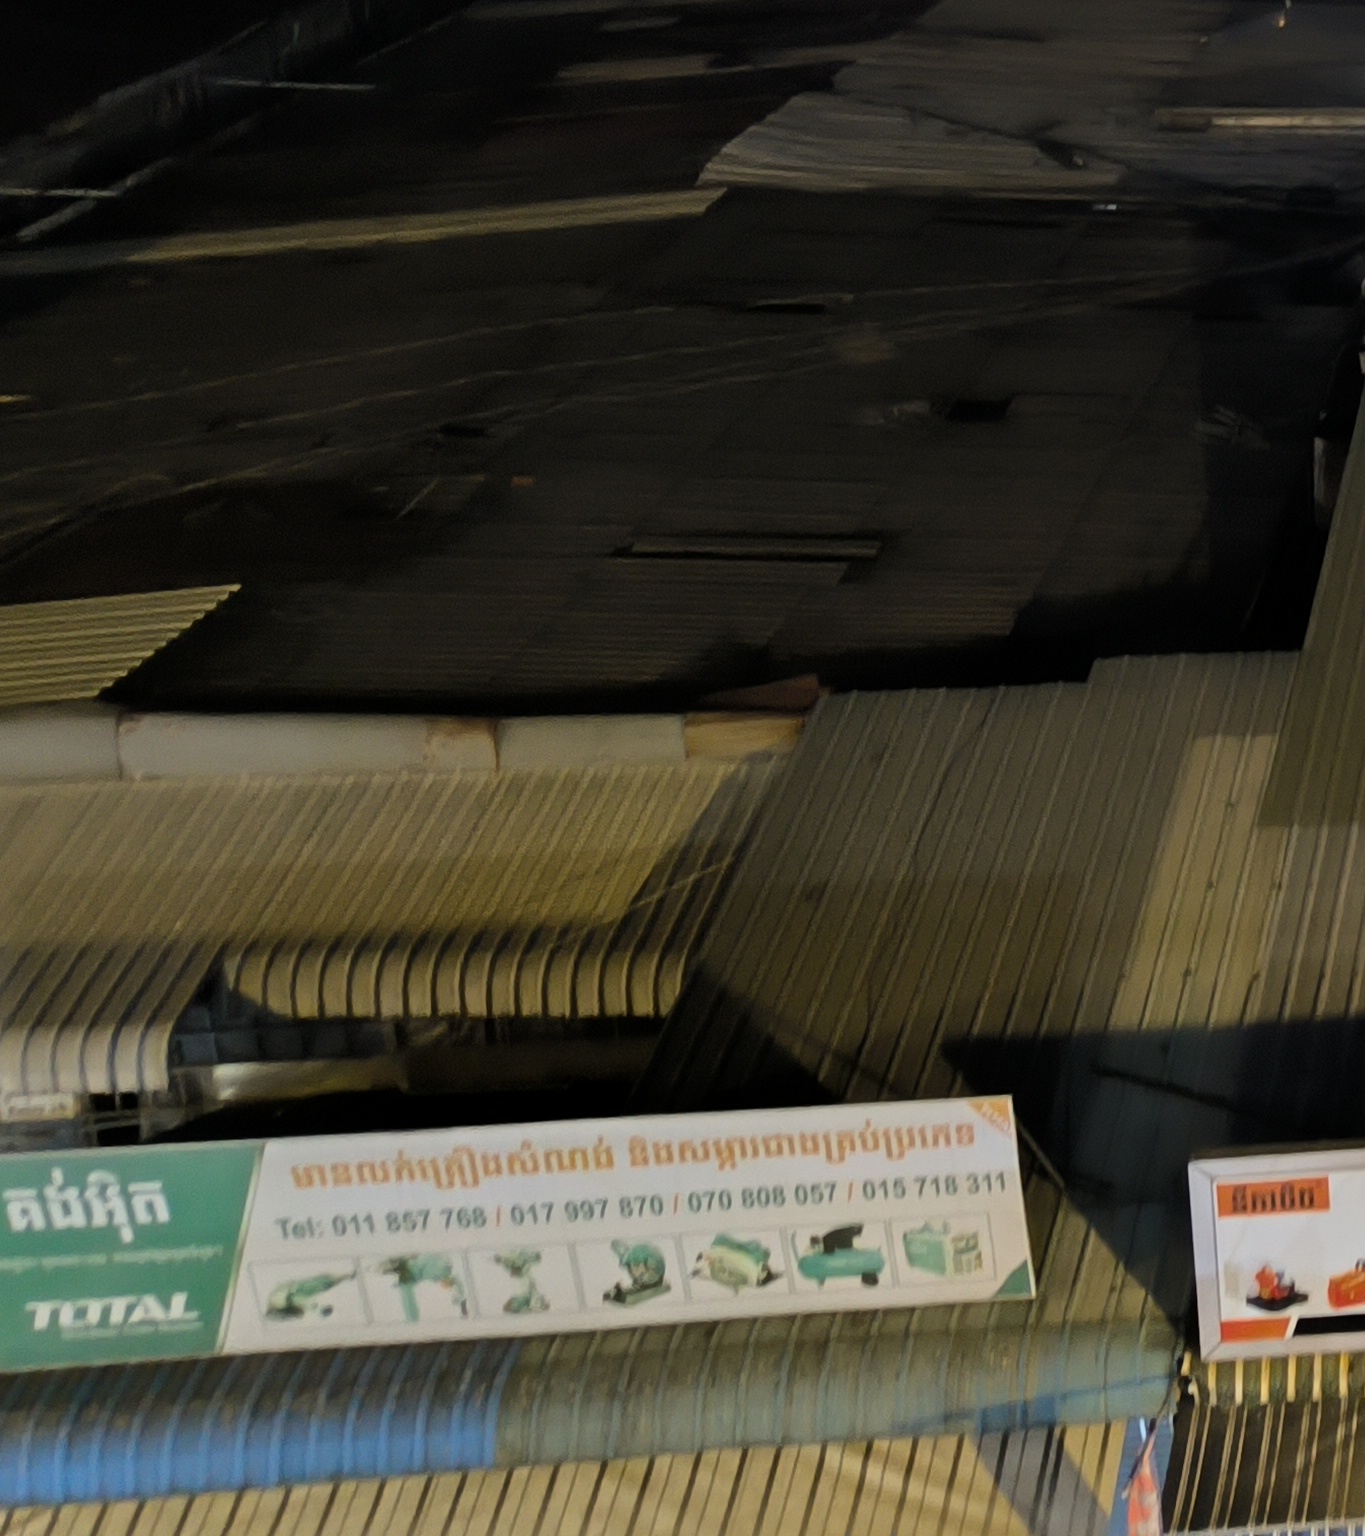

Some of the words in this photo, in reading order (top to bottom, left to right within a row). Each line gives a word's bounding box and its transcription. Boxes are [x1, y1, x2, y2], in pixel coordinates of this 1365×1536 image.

[276, 1216, 324, 1240] Tel:
[332, 1213, 375, 1236] 011
[440, 1206, 487, 1230] 768
[510, 1202, 554, 1225] 017
[564, 1197, 608, 1222] 997
[618, 1194, 664, 1219] 870
[688, 1189, 732, 1213] 070
[741, 1185, 785, 1208] 808
[914, 1169, 957, 1196] 718
[967, 1166, 1006, 1195] 311
[24, 1292, 199, 1331] TOTAL
